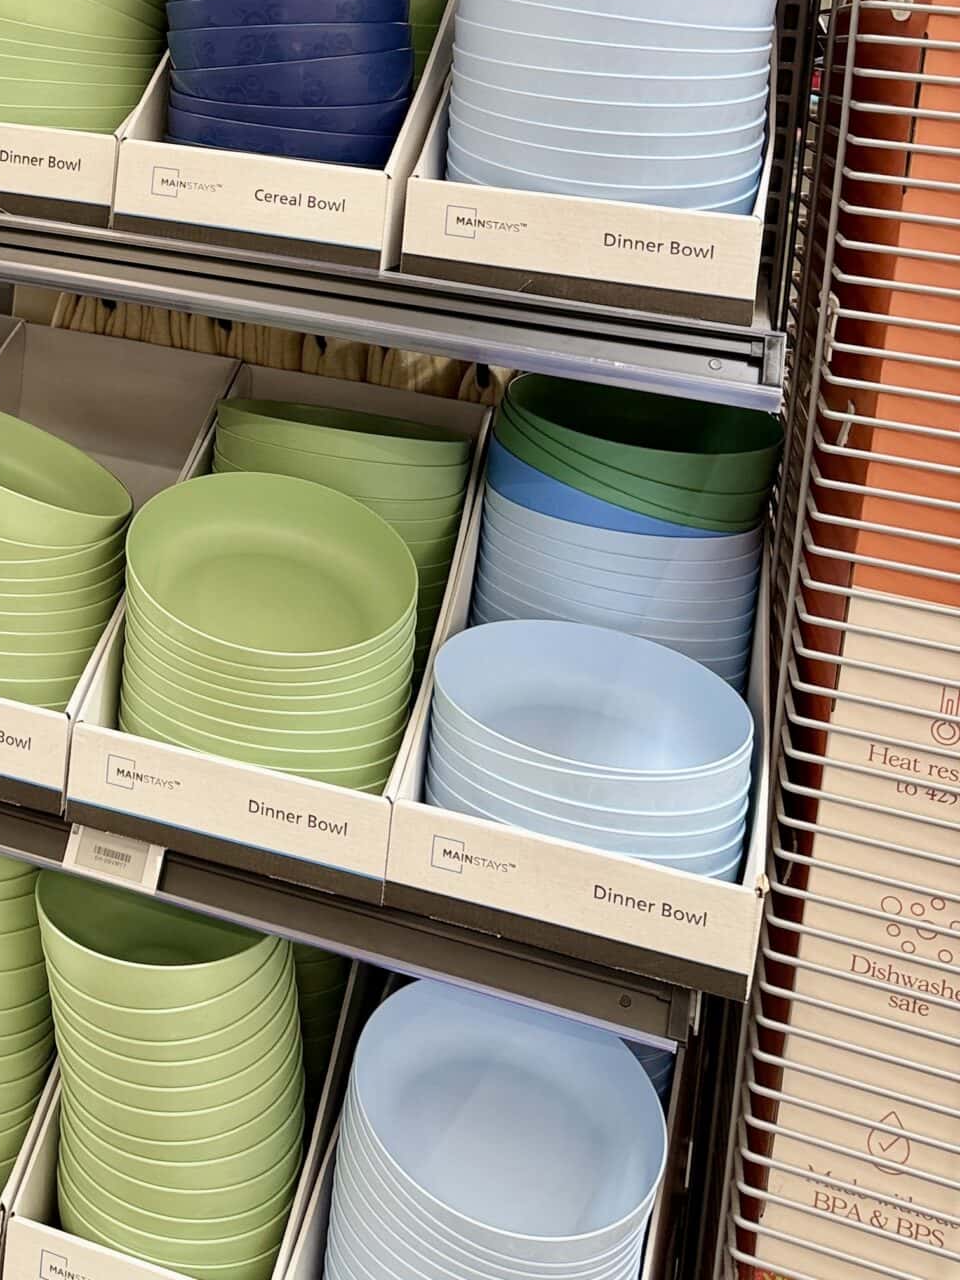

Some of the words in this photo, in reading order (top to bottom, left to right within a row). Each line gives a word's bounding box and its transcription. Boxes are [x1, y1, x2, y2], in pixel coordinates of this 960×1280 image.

[0, 150, 44, 168] Dinner
[49, 156, 81, 172] Bowl
[254, 189, 302, 207] Cereal
[307, 194, 346, 212] Bowl
[603, 232, 664, 254] Dinner
[670, 240, 714, 259] Bowl
[868, 743, 921, 773] Heat
[248, 799, 302, 825] Dinner
[308, 813, 348, 836] Bowl
[593, 884, 655, 914] Dinner
[661, 900, 708, 927] Bowl
[814, 1190, 862, 1221] BPA
[870, 1210, 889, 1231] &
[896, 1218, 945, 1248] BPS
